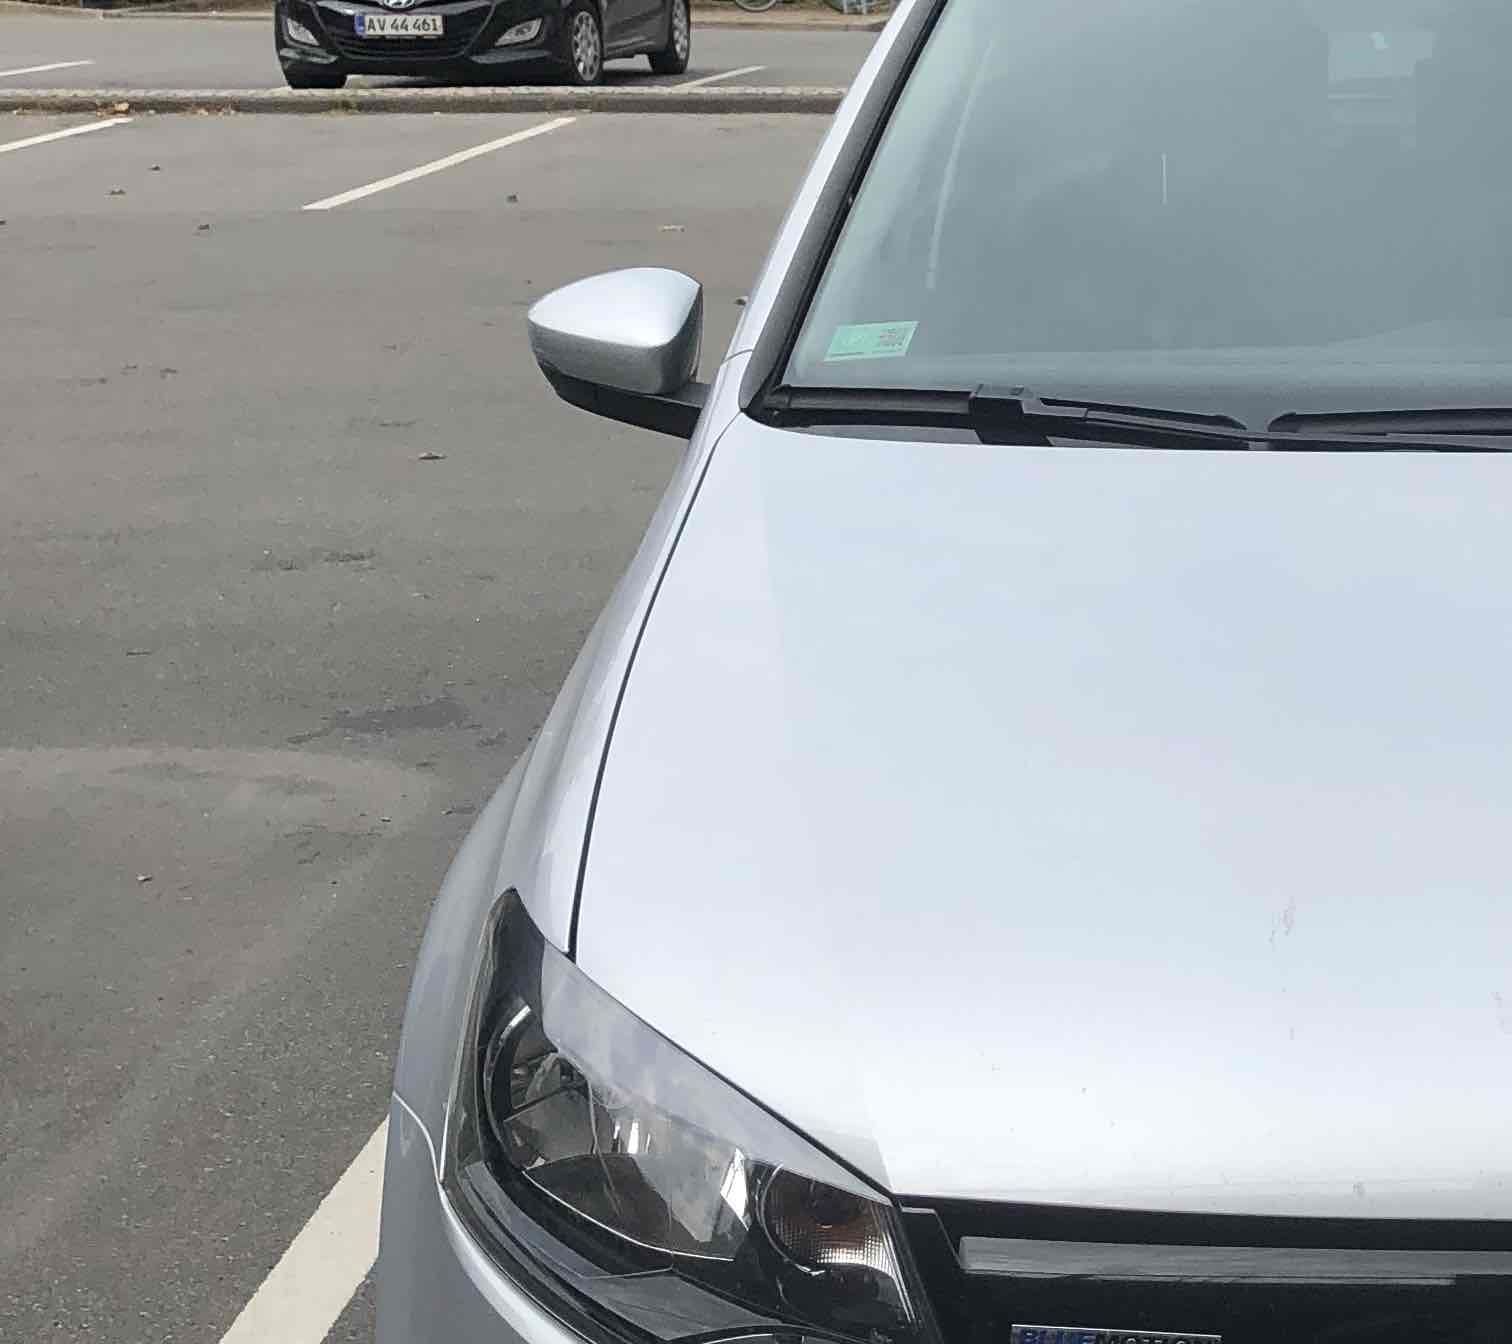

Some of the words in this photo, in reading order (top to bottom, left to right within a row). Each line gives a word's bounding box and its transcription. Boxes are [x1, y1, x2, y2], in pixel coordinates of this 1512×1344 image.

[367, 18, 386, 31] AV
[390, 18, 409, 31] 44
[412, 18, 438, 31] 461
